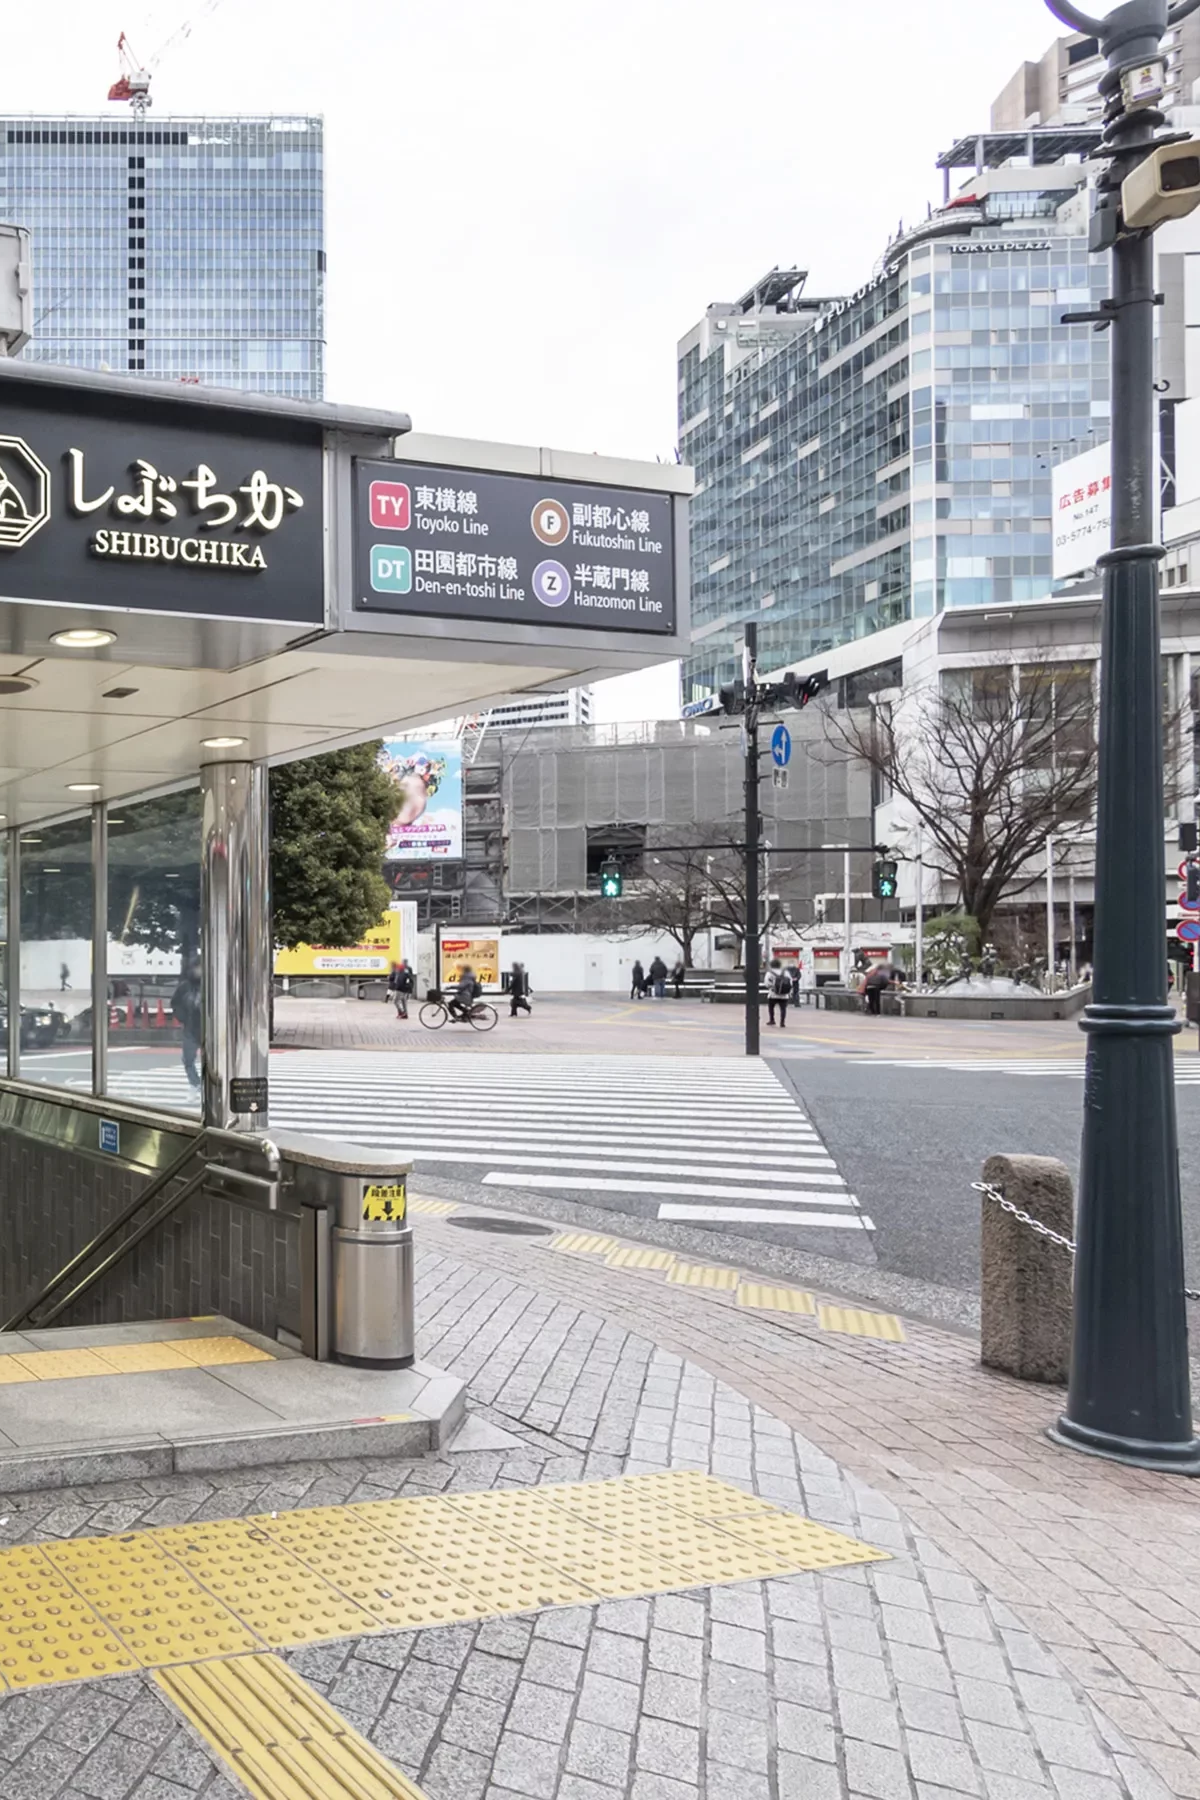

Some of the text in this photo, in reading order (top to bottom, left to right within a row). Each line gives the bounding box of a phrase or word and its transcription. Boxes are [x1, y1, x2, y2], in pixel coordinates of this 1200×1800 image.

[950, 241, 1053, 253] TOKYU PLAZA
[827, 260, 900, 322] FUKURAS
[68, 448, 304, 530] しぶちか
[414, 485, 479, 515] 東横線
[377, 494, 404, 517] TY
[415, 513, 489, 536] Toyoko Line
[546, 516, 556, 530] F
[572, 503, 651, 533] 副都心線
[95, 530, 267, 569] SHIBUCHIKA
[573, 530, 662, 554] Fukutoshin Line
[377, 559, 406, 580] DT
[414, 550, 519, 581] 田園都市線
[415, 577, 525, 602] Den-en-toshi Line
[547, 576, 557, 591] Z
[573, 564, 650, 593] 半蔵門線
[574, 591, 663, 614] Hanzomon Line
